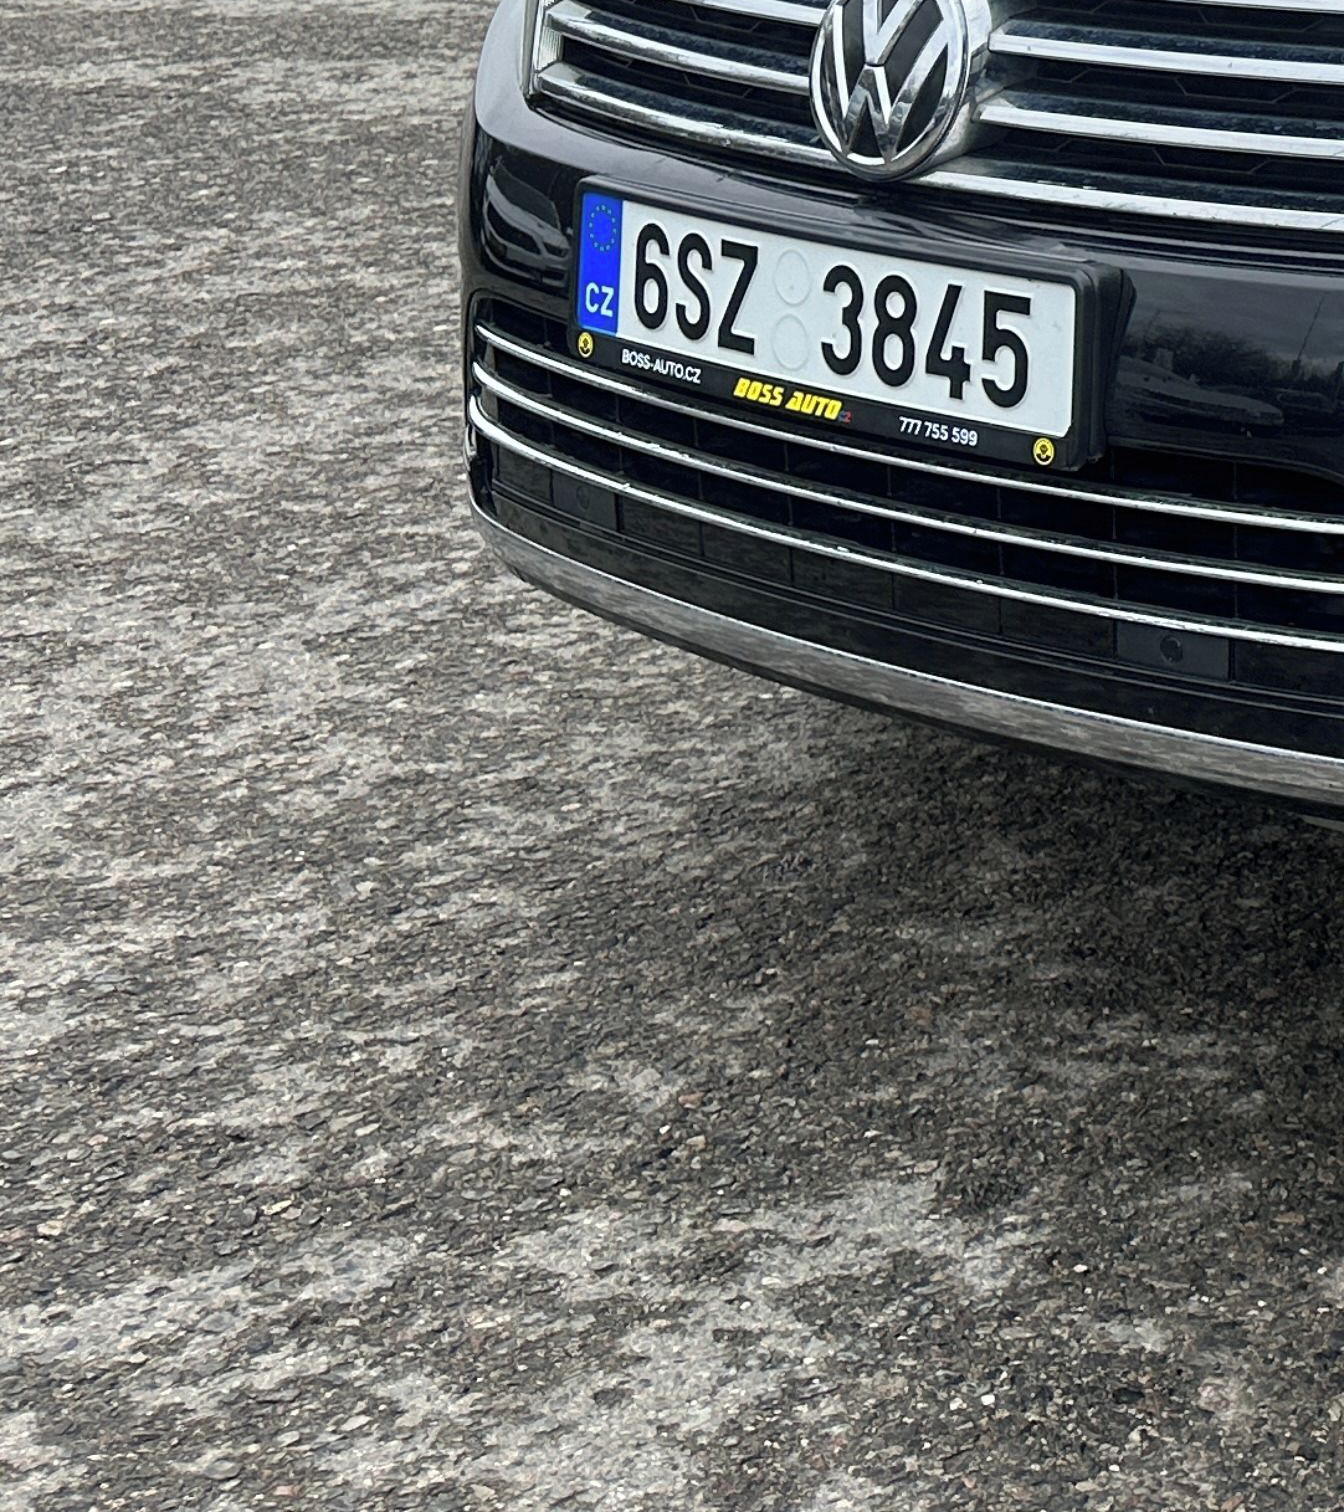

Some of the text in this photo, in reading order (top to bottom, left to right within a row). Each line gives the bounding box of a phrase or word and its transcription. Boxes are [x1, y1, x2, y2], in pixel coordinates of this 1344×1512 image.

[585, 222, 1032, 409] CZ 6SZ 3845
[621, 348, 702, 384] BOSS-AUTO.CZ
[733, 376, 784, 408] BOSS
[785, 391, 842, 421] AUTO
[898, 416, 979, 447] 777 755 599
